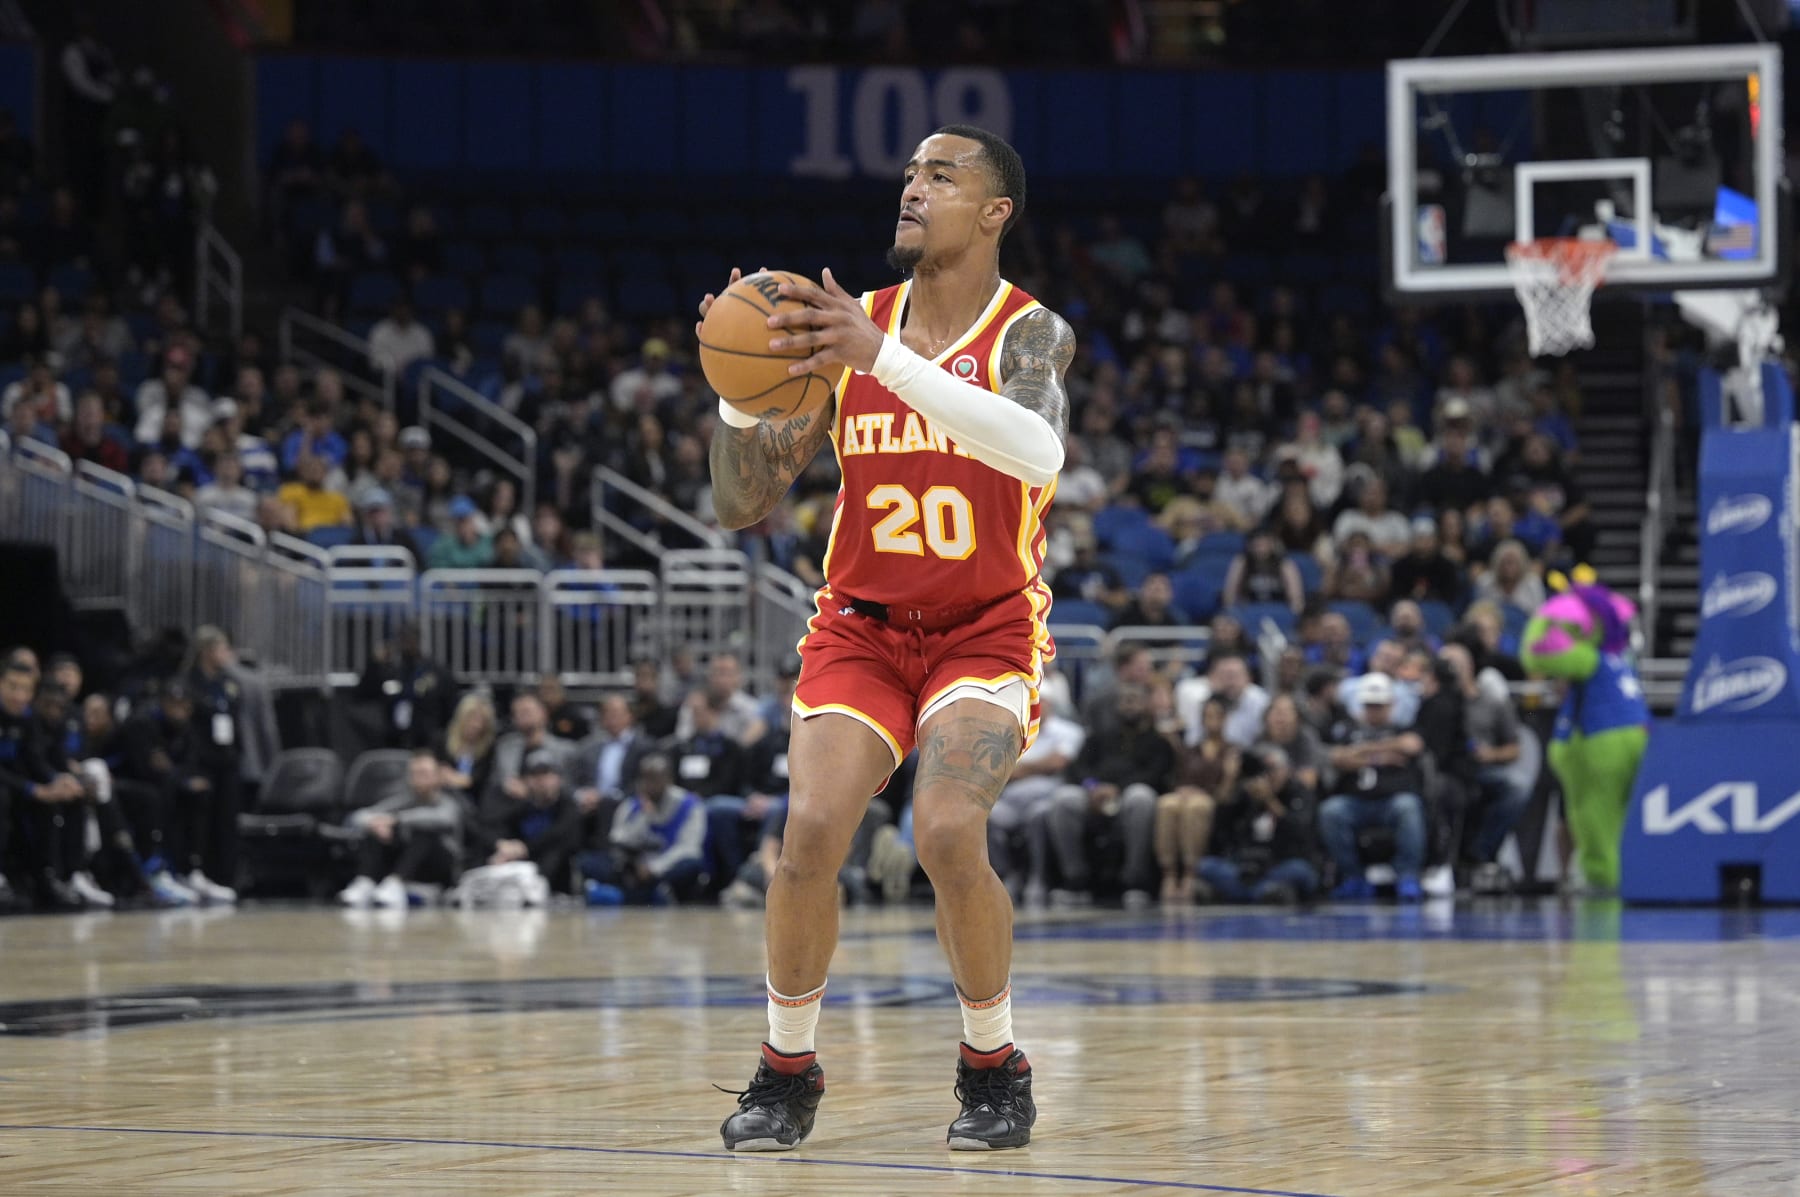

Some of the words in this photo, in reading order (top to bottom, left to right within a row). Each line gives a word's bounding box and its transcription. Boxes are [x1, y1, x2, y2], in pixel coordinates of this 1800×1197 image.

[787, 66, 1012, 178] 109
[842, 411, 976, 459] ATLAN
[866, 484, 976, 560] 20
